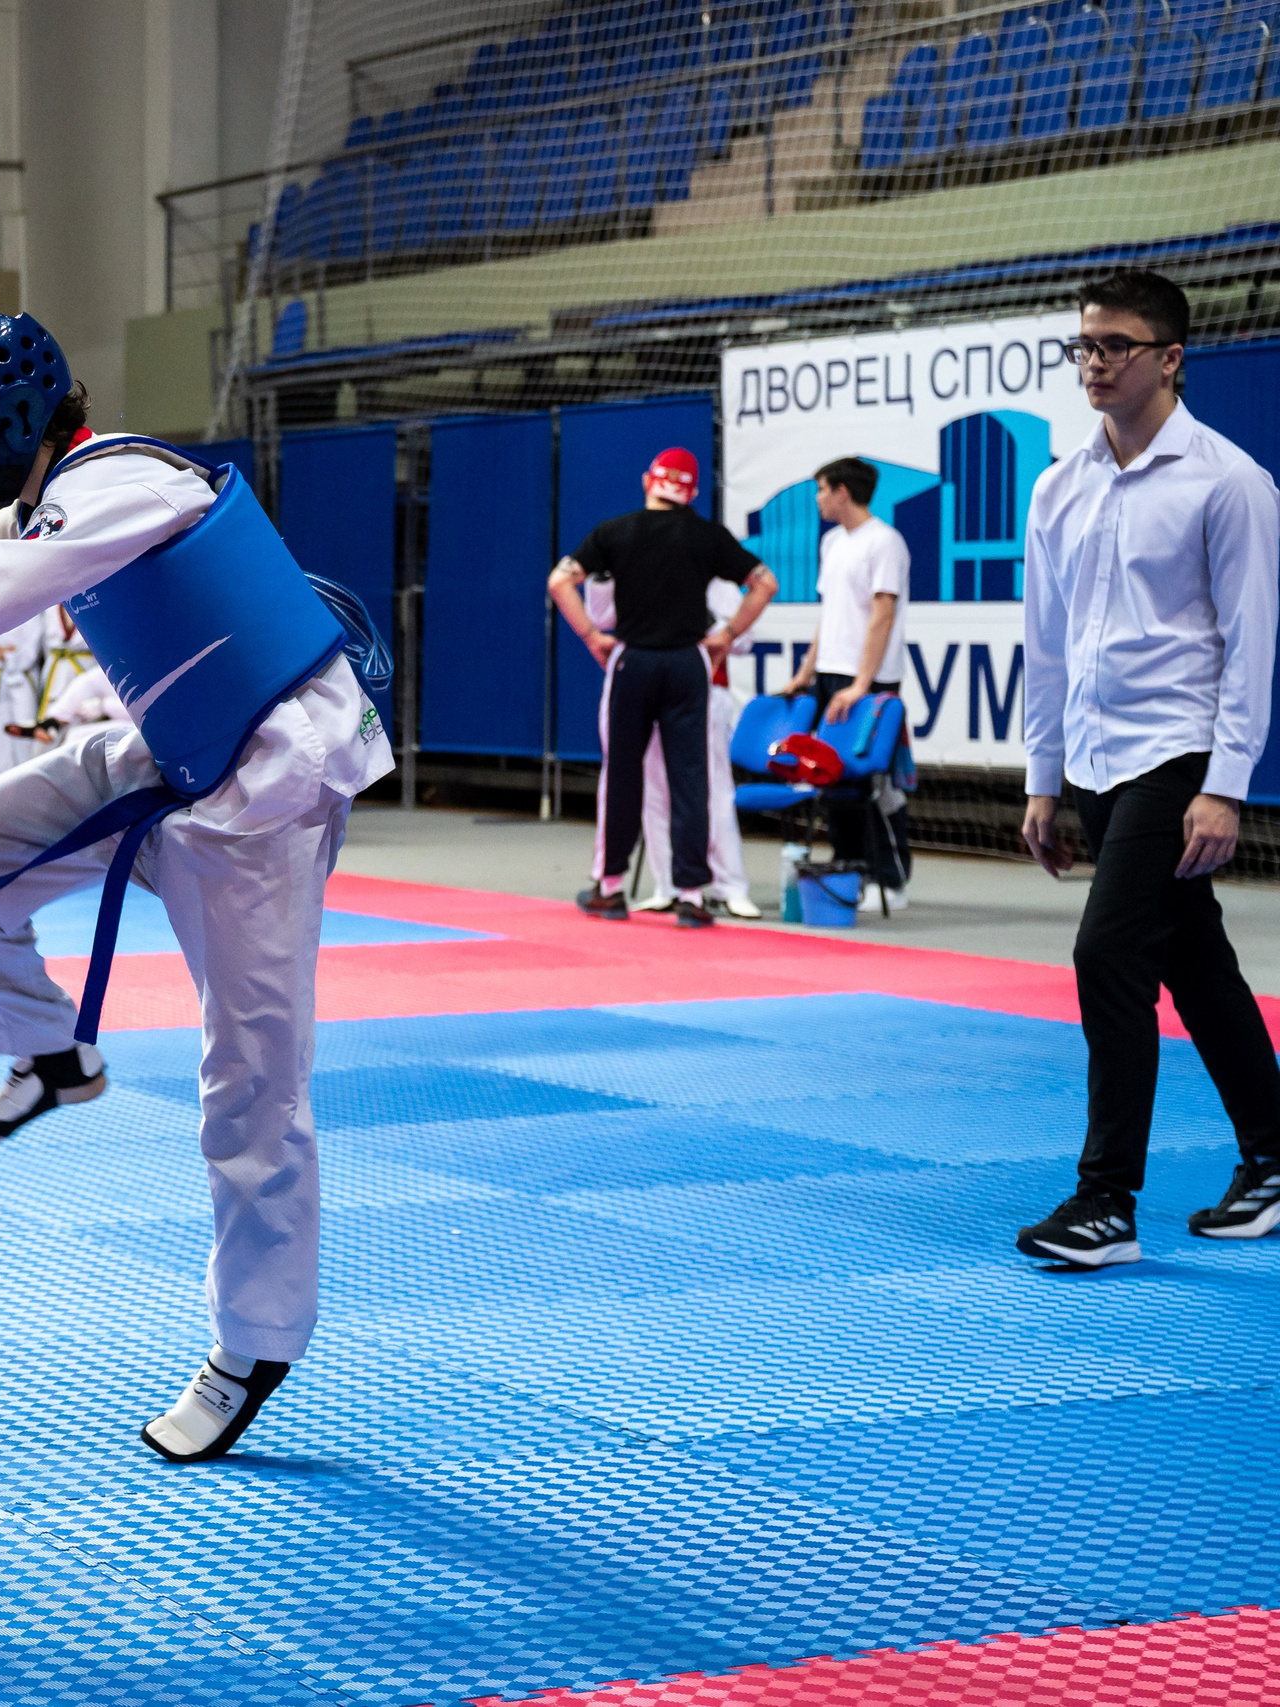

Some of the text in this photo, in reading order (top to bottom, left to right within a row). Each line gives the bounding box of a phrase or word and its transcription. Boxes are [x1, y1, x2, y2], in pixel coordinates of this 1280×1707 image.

[736, 352, 914, 427] ДВОРЕЦ
[84, 592, 97, 603] WT
[179, 765, 196, 784] 2
[219, 1400, 235, 1411] WT
